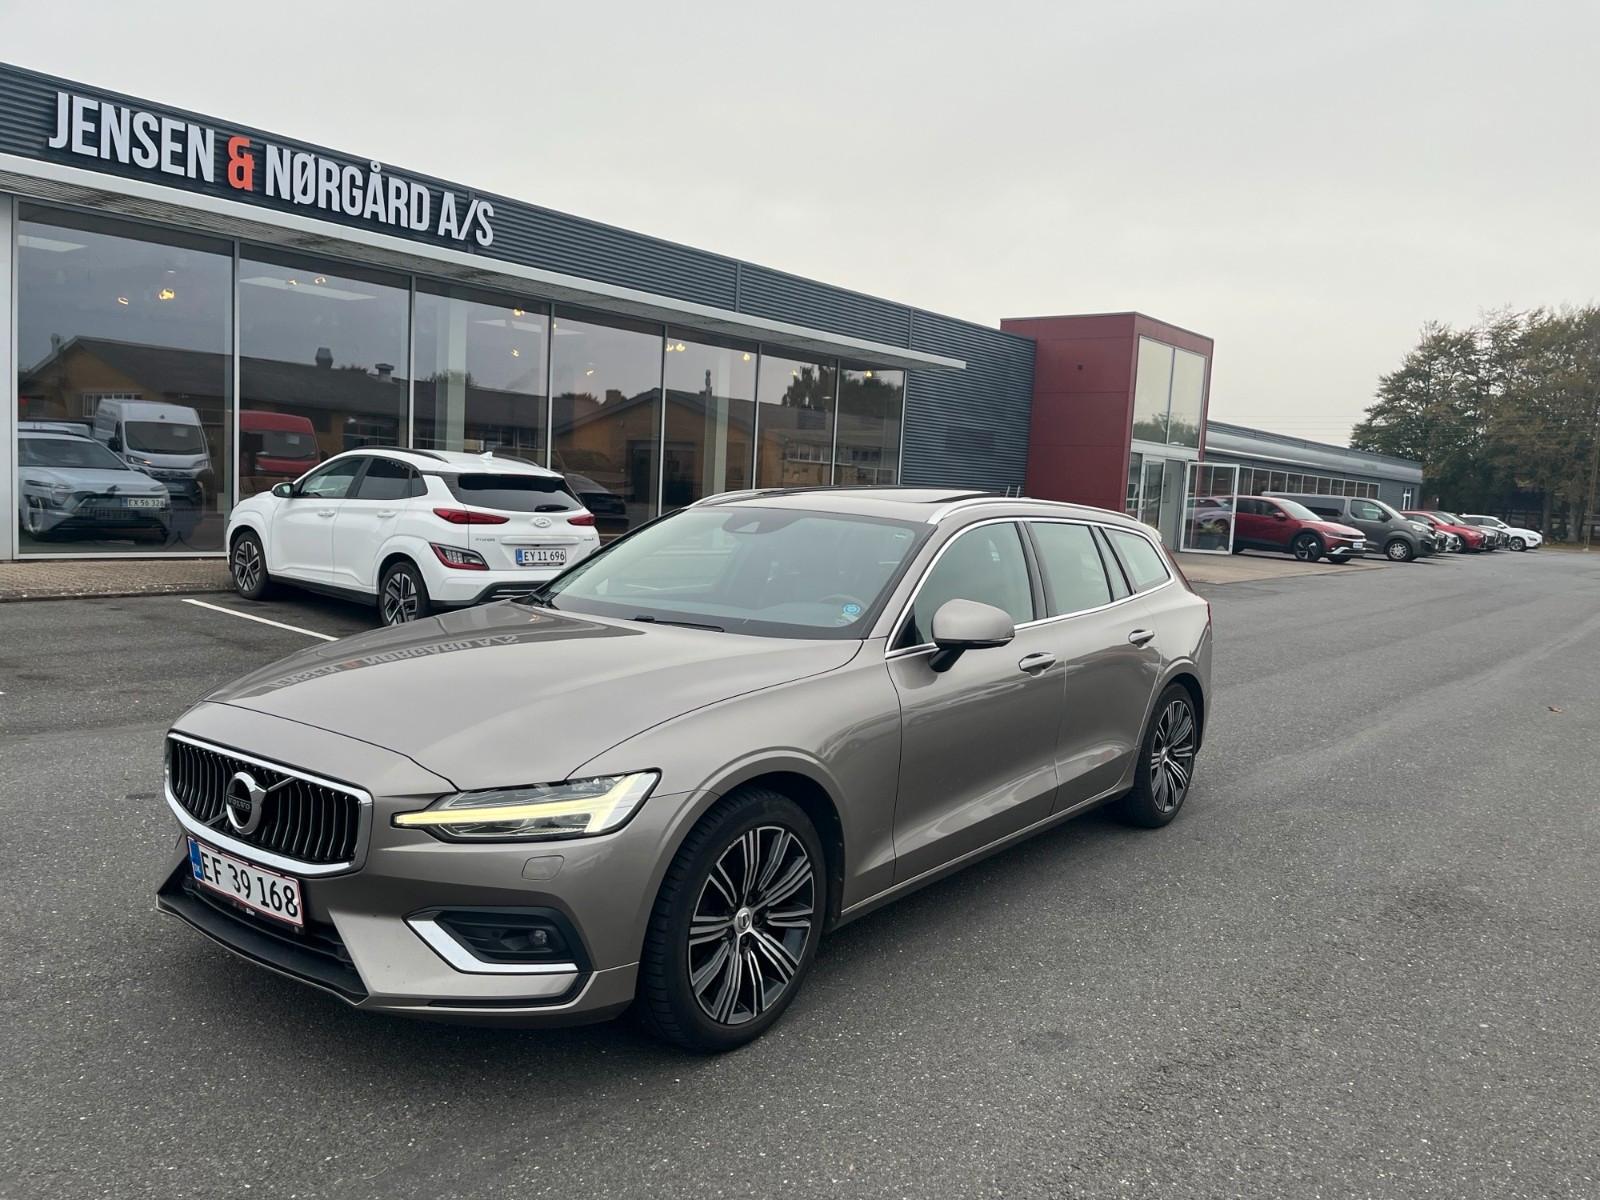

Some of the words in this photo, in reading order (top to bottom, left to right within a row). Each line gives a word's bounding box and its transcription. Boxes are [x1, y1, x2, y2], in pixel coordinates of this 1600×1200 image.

[48, 91, 215, 183] JENSEN
[227, 136, 253, 192] &
[265, 143, 430, 231] NØRGÅRD
[437, 191, 494, 247] A/S
[524, 551, 536, 561] EY
[537, 551, 548, 561] 11
[550, 550, 565, 561] 696
[227, 796, 251, 810] VOLVO
[200, 851, 222, 885] EF
[227, 863, 251, 899] 39
[257, 876, 298, 917] 168
